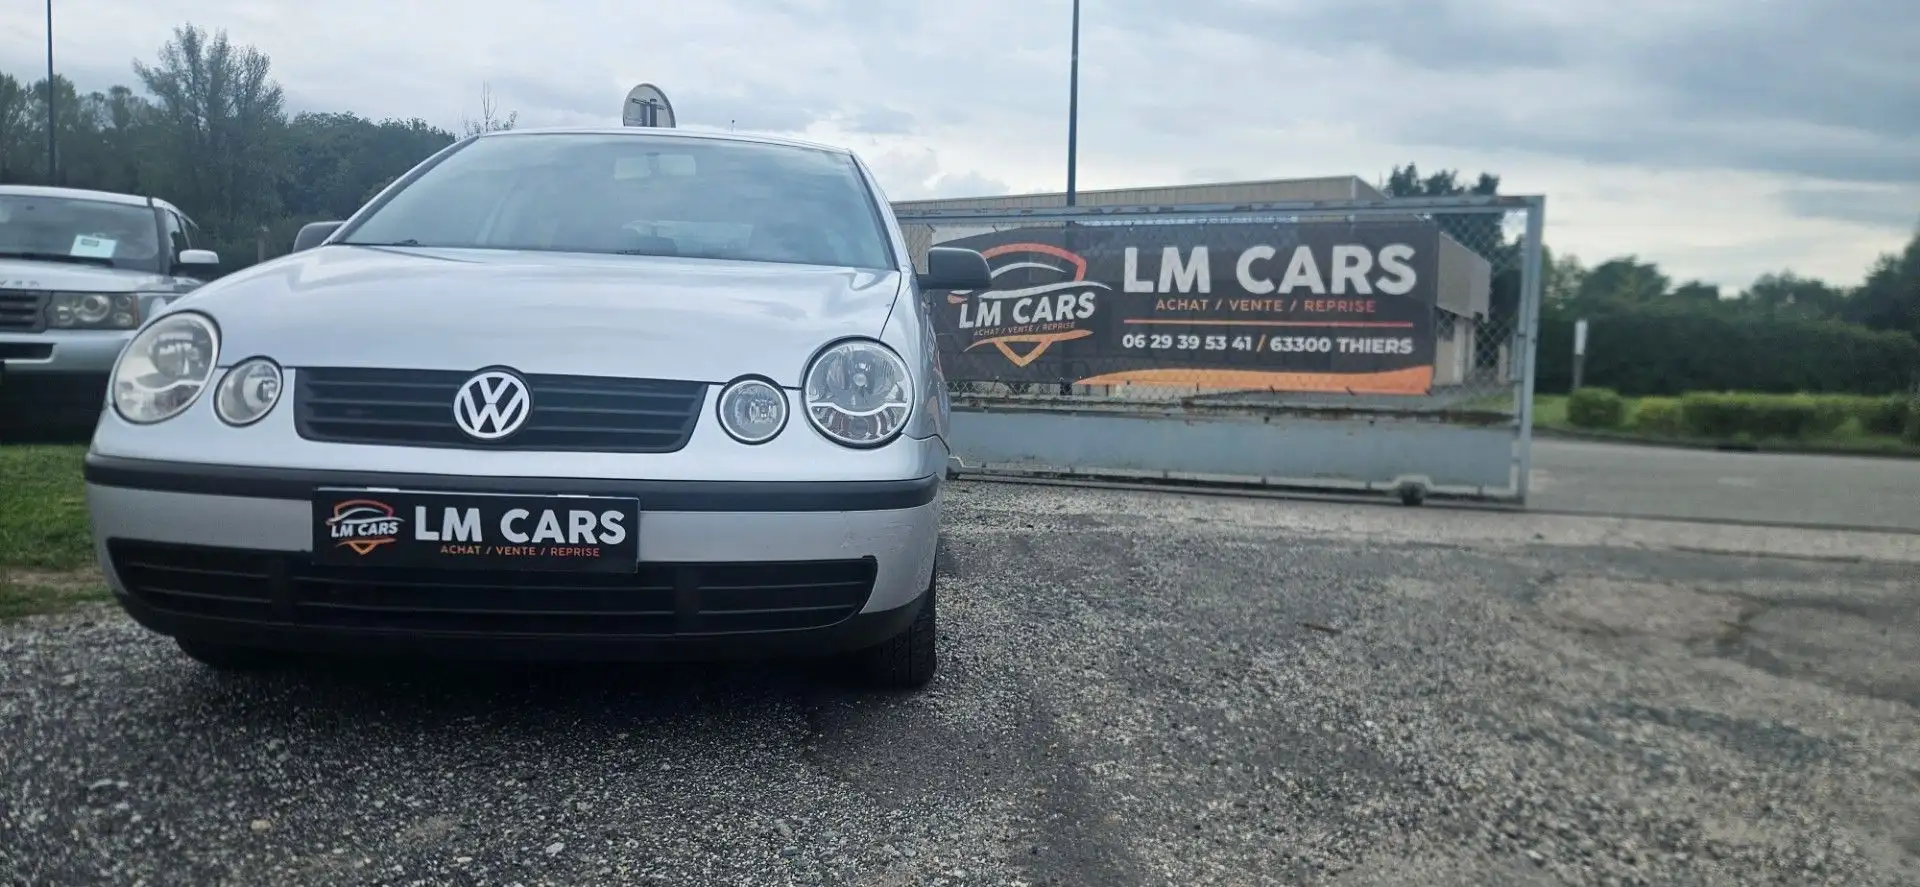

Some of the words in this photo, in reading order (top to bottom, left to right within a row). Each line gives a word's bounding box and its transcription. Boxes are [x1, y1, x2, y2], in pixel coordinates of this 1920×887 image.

[1123, 245, 1211, 294] LM
[1235, 244, 1417, 296] CARS
[959, 300, 1001, 329] LM
[1012, 292, 1096, 324] CARS
[1155, 299, 1208, 311] ACHAT
[1215, 299, 1222, 312] /
[1229, 299, 1284, 312] VENTE
[1289, 299, 1297, 312] /
[1304, 300, 1376, 313] REPRISE
[1122, 334, 1146, 350] 06
[1150, 334, 1172, 351] 29
[1177, 335, 1200, 351] 39
[1205, 335, 1227, 351] 53
[1231, 336, 1252, 352] 41
[1256, 335, 1267, 352] /
[1270, 336, 1331, 353] 63300
[1336, 337, 1414, 354] THIERS
[331, 524, 354, 538] LM
[358, 521, 399, 536] CARS
[414, 505, 483, 542] LM
[499, 508, 627, 545] CARS
[440, 545, 482, 555] ACHAT
[486, 545, 491, 555] /
[496, 546, 536, 556] VENTE
[540, 546, 546, 556] /
[551, 547, 600, 557] REPRISE
